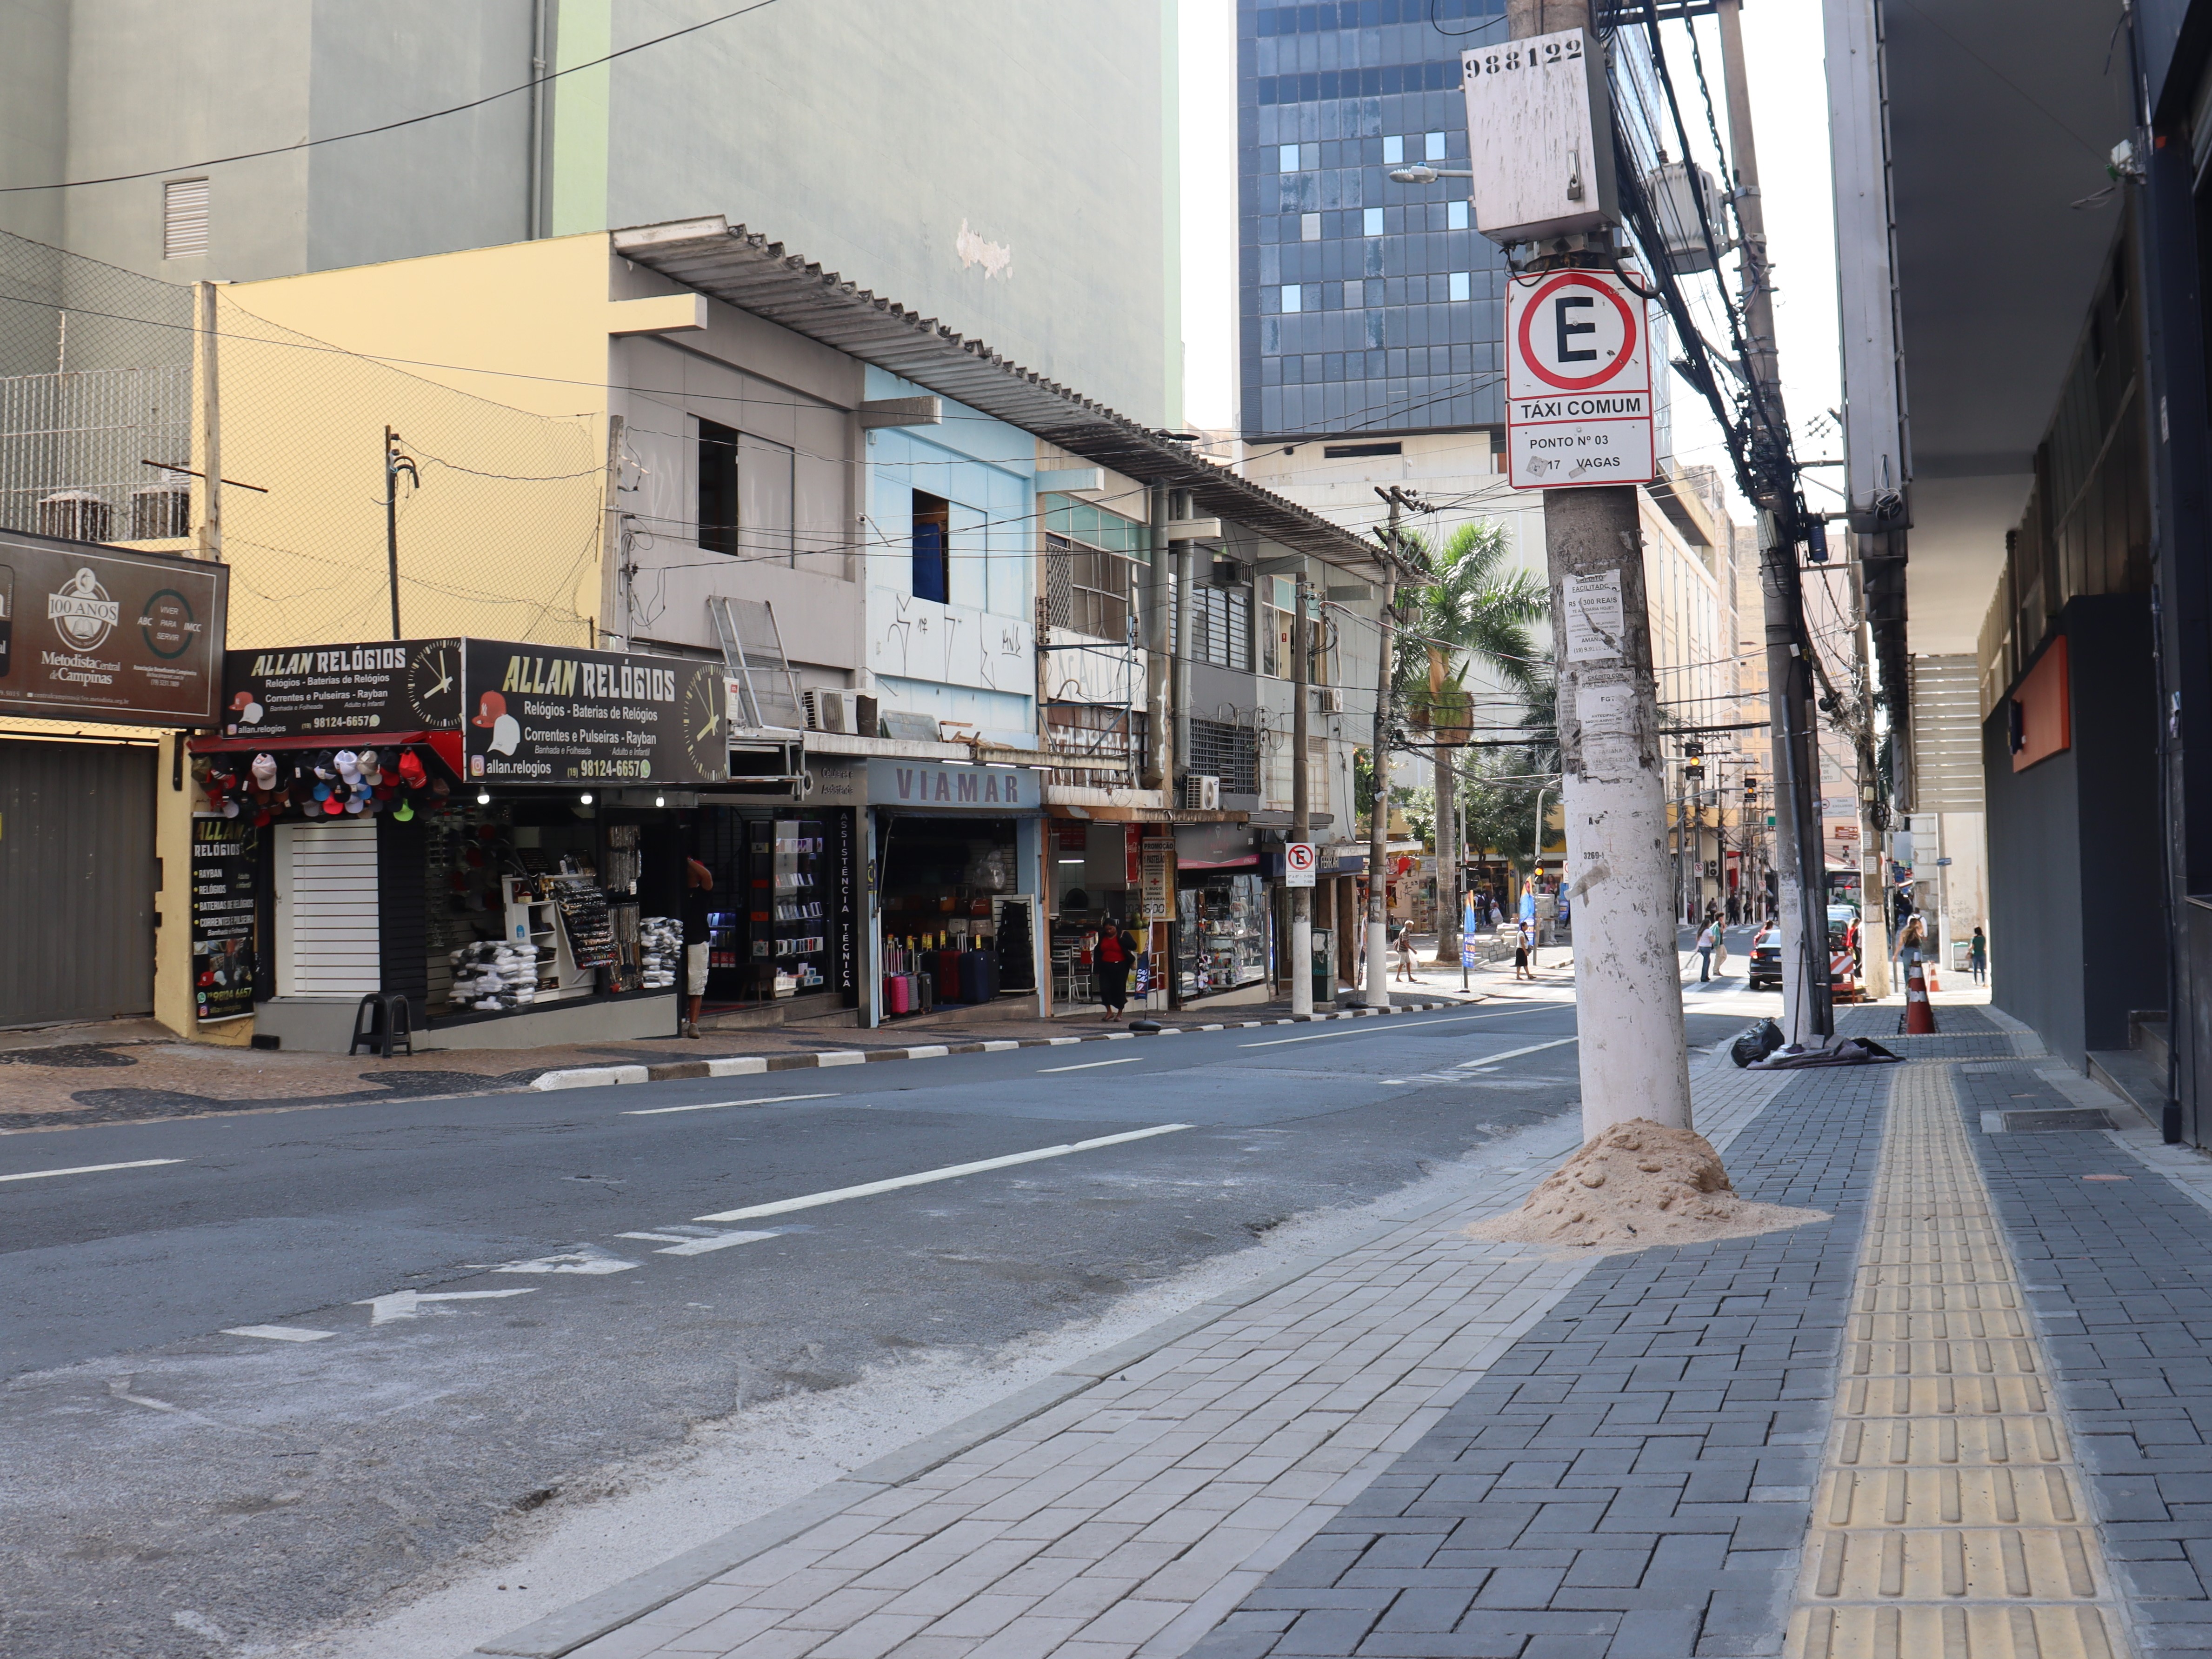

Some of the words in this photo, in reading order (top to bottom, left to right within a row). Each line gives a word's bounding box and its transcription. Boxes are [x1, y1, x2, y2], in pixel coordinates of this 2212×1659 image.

[1465, 40, 1581, 78] 988122
[1555, 296, 1597, 363] E
[1521, 400, 1561, 419] TÁXI
[1567, 398, 1641, 415] COMUM
[1530, 437, 1574, 449] PONTO
[1594, 435, 1609, 445] 03
[1548, 460, 1561, 470] 17
[1576, 457, 1621, 468] VAGAS
[50, 599, 72, 613] 100
[74, 602, 117, 620] ANOS
[160, 606, 179, 614] VIVER
[137, 616, 153, 626] ABC
[160, 619, 177, 628] PARA
[183, 622, 202, 632] IMCC
[156, 632, 179, 641] SERVIR
[251, 652, 314, 677] ALLAN
[316, 645, 406, 673] RELÓGIOS
[58, 667, 113, 687] Campinas
[265, 678, 300, 689] Relógios
[307, 675, 341, 686] Baterias
[342, 675, 353, 685] de
[354, 673, 390, 685] Relógios
[502, 655, 579, 698] ALLAN
[580, 658, 675, 703] RELÓGIOS
[265, 693, 305, 703] Correntes
[313, 691, 350, 701] Pulseiras
[357, 689, 388, 700] Rayban
[524, 701, 565, 720] Relógios
[572, 703, 608, 720] Baterias
[610, 706, 621, 719] de
[622, 706, 658, 723] Relógios
[313, 714, 370, 728] 98124-6657
[238, 724, 286, 735] allan.relogios
[524, 726, 570, 743] Correntes
[572, 732, 578, 743] e
[580, 728, 620, 744] Pulseiras
[626, 732, 657, 749] Rayban
[534, 746, 560, 755] Banhada
[566, 746, 592, 755] Folheada
[611, 747, 629, 756] Adulto
[633, 748, 650, 757] Infantil
[486, 760, 552, 778] allan.relogios
[567, 766, 579, 778] (19)
[580, 760, 640, 777] 98124-6657
[895, 767, 1019, 804] VIAMAR
[194, 842, 240, 857] RELÓGIOS
[1144, 842, 1173, 851] PROMOÇÃO
[840, 812, 850, 913] ASSISTÊNCIA
[199, 868, 223, 879] RAYBAN
[199, 883, 227, 895] RELÓGIOS
[199, 900, 227, 911] BATERIAS
[200, 916, 230, 927] CORRENTES
[842, 923, 851, 988] TÉCNICA
